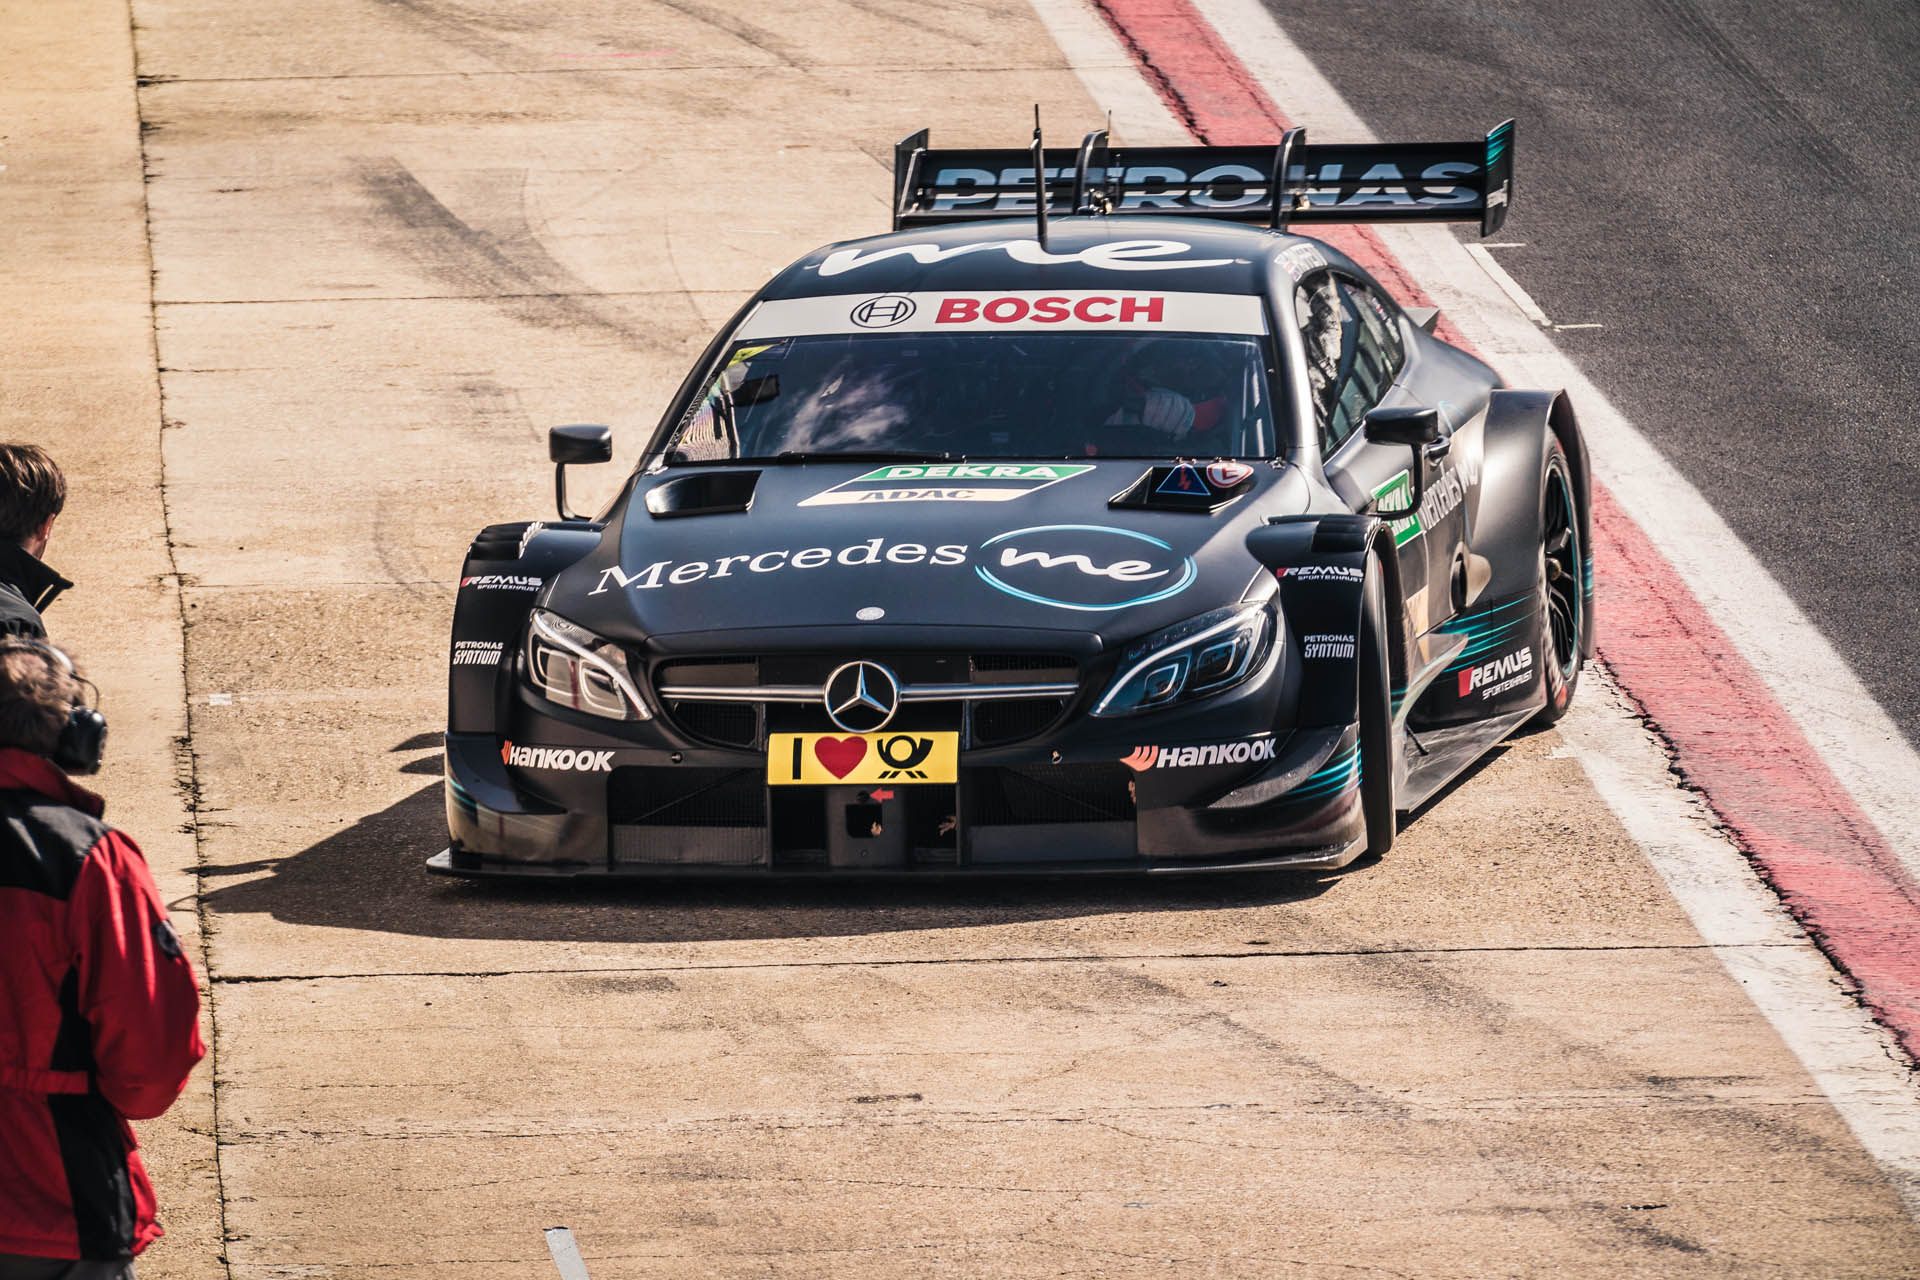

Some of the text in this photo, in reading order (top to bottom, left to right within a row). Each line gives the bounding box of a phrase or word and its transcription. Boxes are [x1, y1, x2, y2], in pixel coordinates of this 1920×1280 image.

[932, 162, 1481, 210] PETRONAS
[815, 240, 1236, 277] me
[935, 297, 1164, 324] BOSCH
[886, 465, 1058, 479] DEKRA
[859, 489, 977, 501] ADAC
[588, 537, 1169, 597] Mercedes me
[1283, 566, 1364, 577] REMUS
[466, 575, 543, 587] REMUS
[1298, 575, 1363, 583] SPORTEXHAUST
[477, 583, 540, 592] SPORTEXHAUST
[1304, 634, 1355, 642] PETRONAS
[455, 641, 504, 650] PETRONAS
[1304, 643, 1355, 658] SYNTIUM
[453, 650, 501, 665] SYNTIUM
[1469, 646, 1533, 691] REMUS
[792, 737, 803, 780] I
